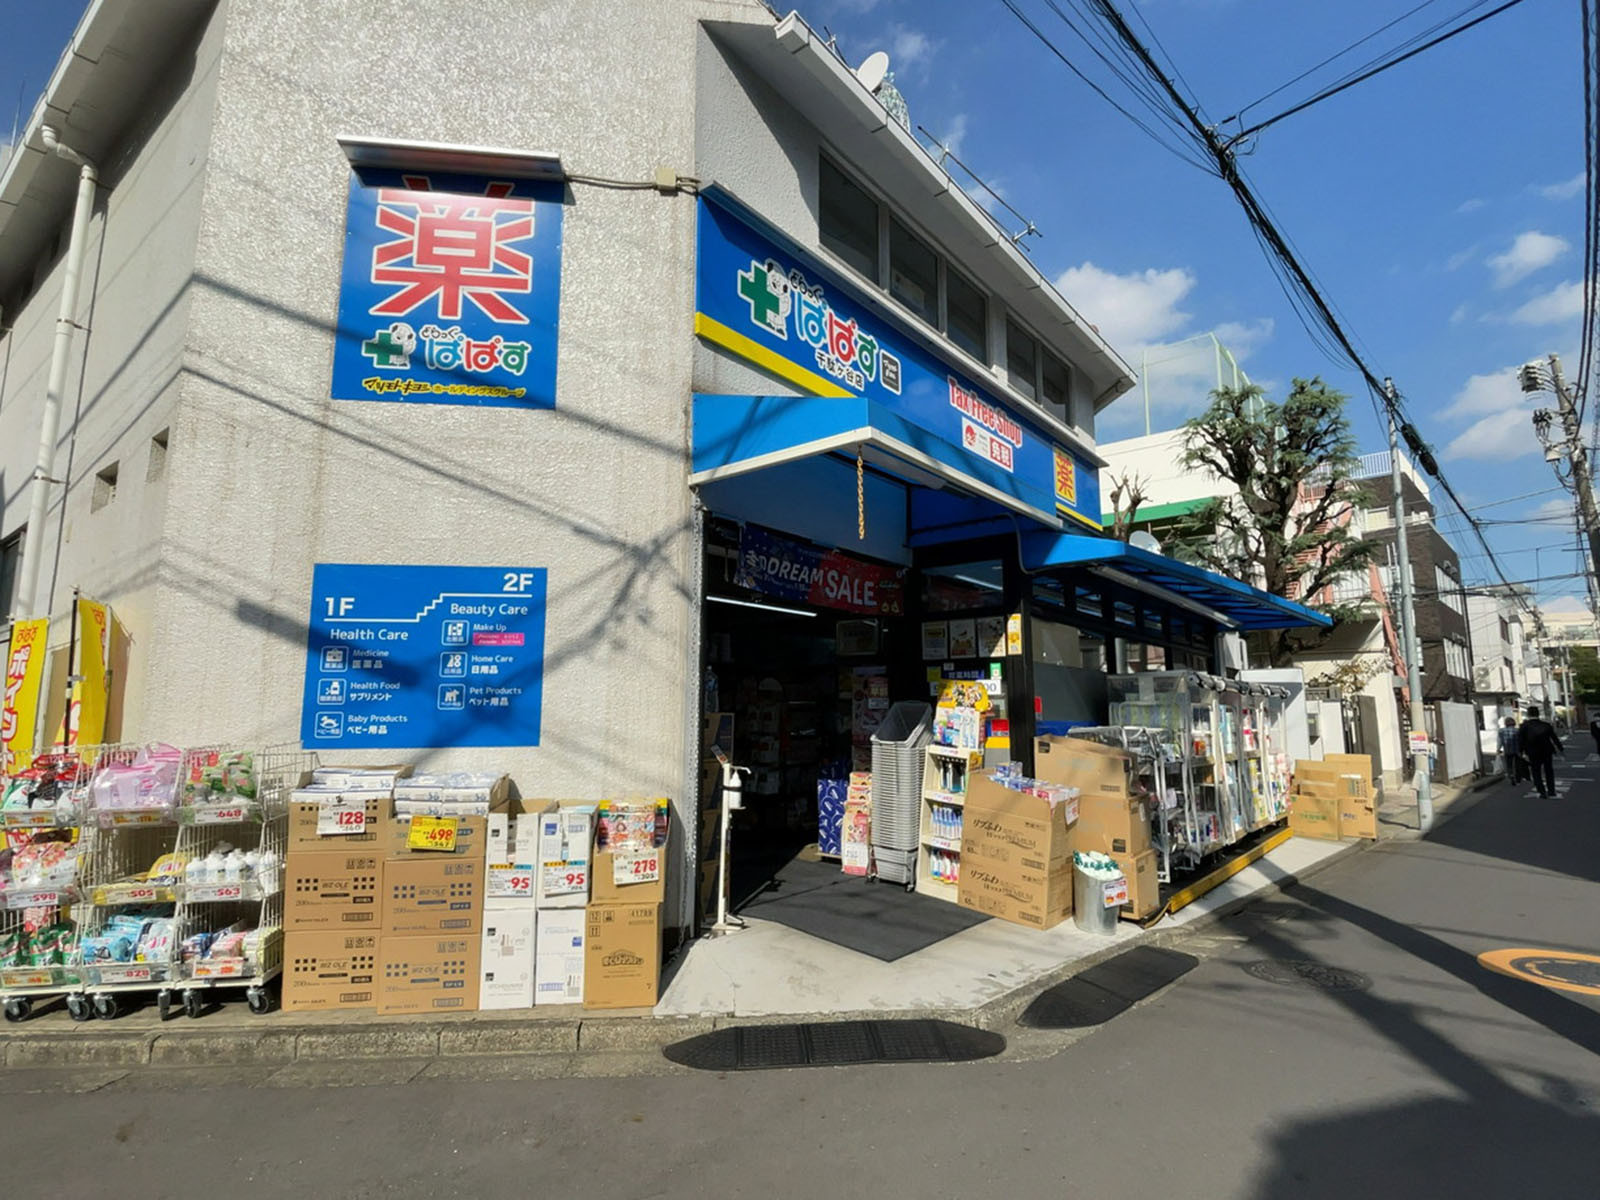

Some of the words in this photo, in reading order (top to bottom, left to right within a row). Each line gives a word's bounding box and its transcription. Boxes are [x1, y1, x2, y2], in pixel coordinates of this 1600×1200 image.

[369, 175, 536, 324] 薬
[421, 326, 460, 340] どらっぐ
[796, 290, 877, 379] ぱぱす
[427, 335, 531, 374] ぱぱす
[949, 377, 970, 412] Tax
[970, 391, 995, 429] Free
[996, 409, 1021, 447] Shop
[1055, 450, 1074, 499] 薬
[503, 573, 533, 592] 2F
[825, 568, 879, 607] SALE
[324, 597, 355, 616] 1F
[450, 603, 494, 617] Beauty
[499, 604, 528, 615] Care
[330, 628, 374, 640] Health
[378, 629, 409, 640] Care
[473, 623, 493, 632] Make
[495, 624, 507, 632] Up
[352, 649, 390, 658] Medicine
[472, 655, 492, 664] Home
[494, 655, 514, 664] Care
[471, 665, 499, 674] 日用品
[350, 682, 378, 690] Health
[380, 682, 401, 690] Food
[469, 686, 483, 695] Pet
[485, 686, 522, 695] Products
[348, 715, 371, 724] Baby
[372, 715, 408, 723] Products
[346, 725, 388, 735] ベビー用品
[339, 811, 364, 825] 128
[429, 828, 453, 840] 498
[634, 859, 657, 874] 278
[511, 876, 529, 889] 95
[565, 873, 585, 885] 95
[217, 888, 240, 897] 563
